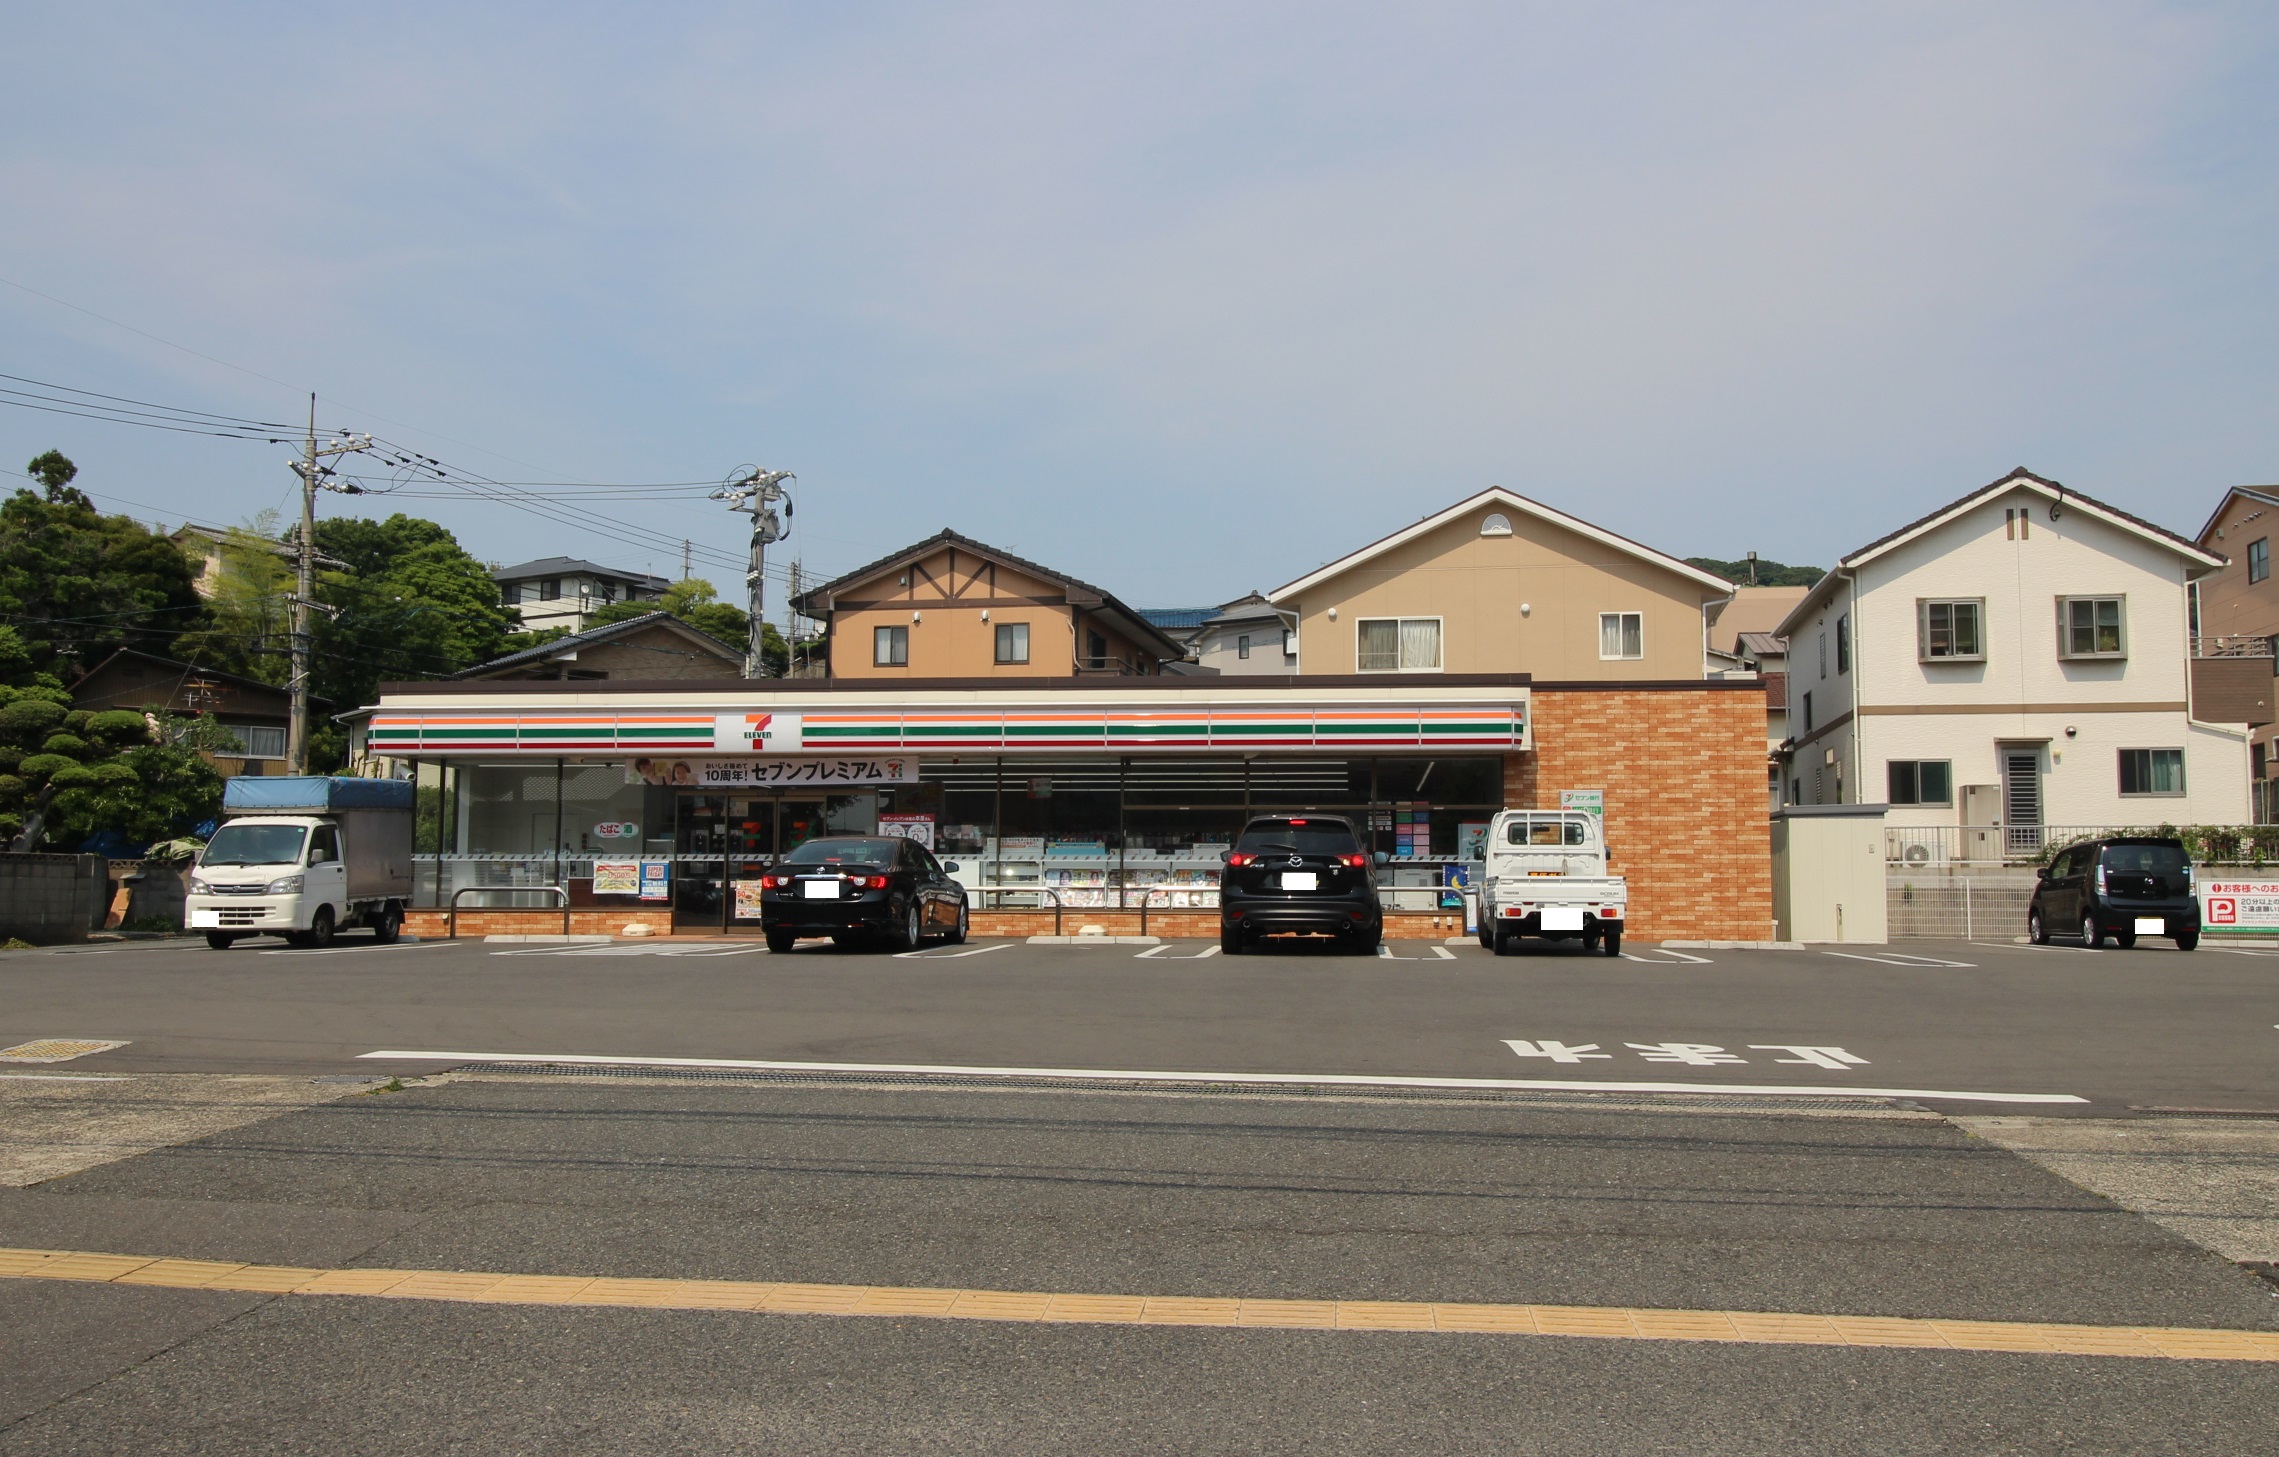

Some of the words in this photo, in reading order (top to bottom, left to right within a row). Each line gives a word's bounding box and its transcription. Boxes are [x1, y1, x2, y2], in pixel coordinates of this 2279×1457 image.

[745, 714, 772, 749] 7
[751, 761, 882, 781] セブンプレミアム
[600, 824, 620, 834] たばこ
[623, 824, 633, 834] 酒
[2223, 884, 2279, 893] お客様へのお
